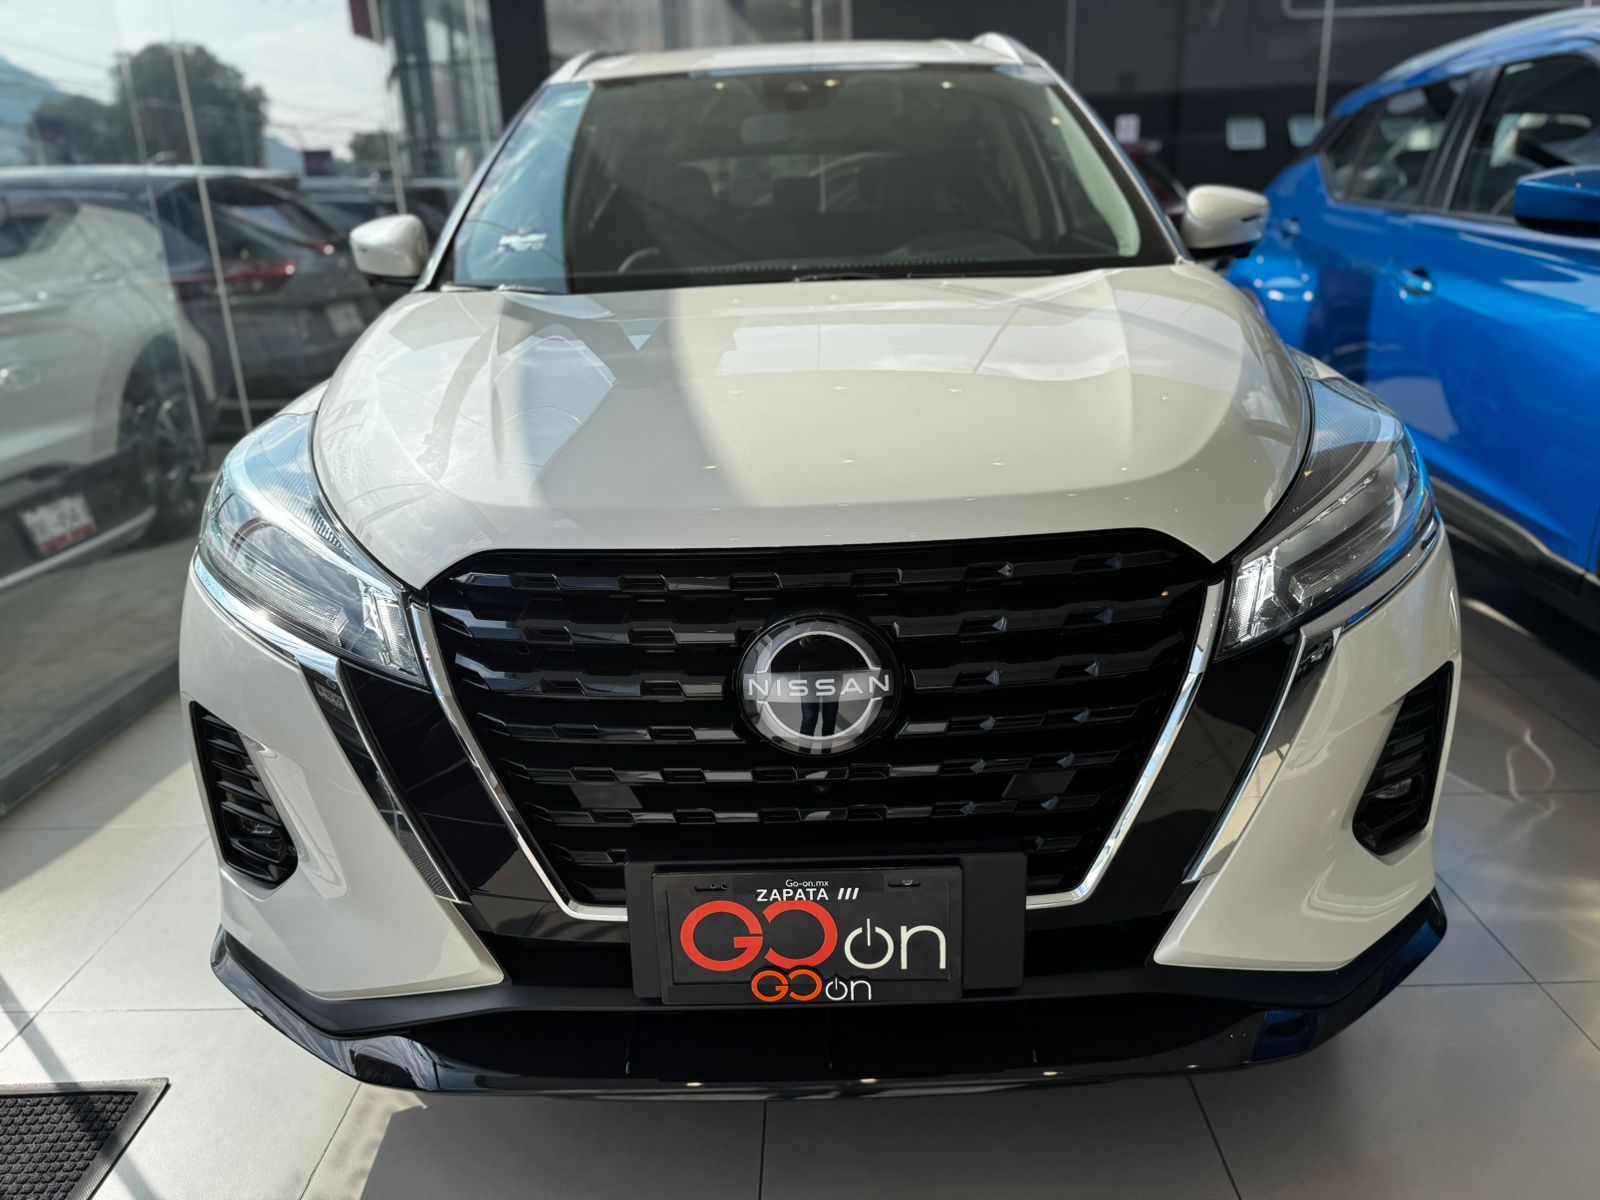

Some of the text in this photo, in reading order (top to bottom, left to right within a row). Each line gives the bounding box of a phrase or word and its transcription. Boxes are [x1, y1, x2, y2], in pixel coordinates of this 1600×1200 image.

[748, 674, 890, 697] NISSAN
[785, 879, 829, 887] Go-on.mx
[756, 888, 829, 902] ZAPATA
